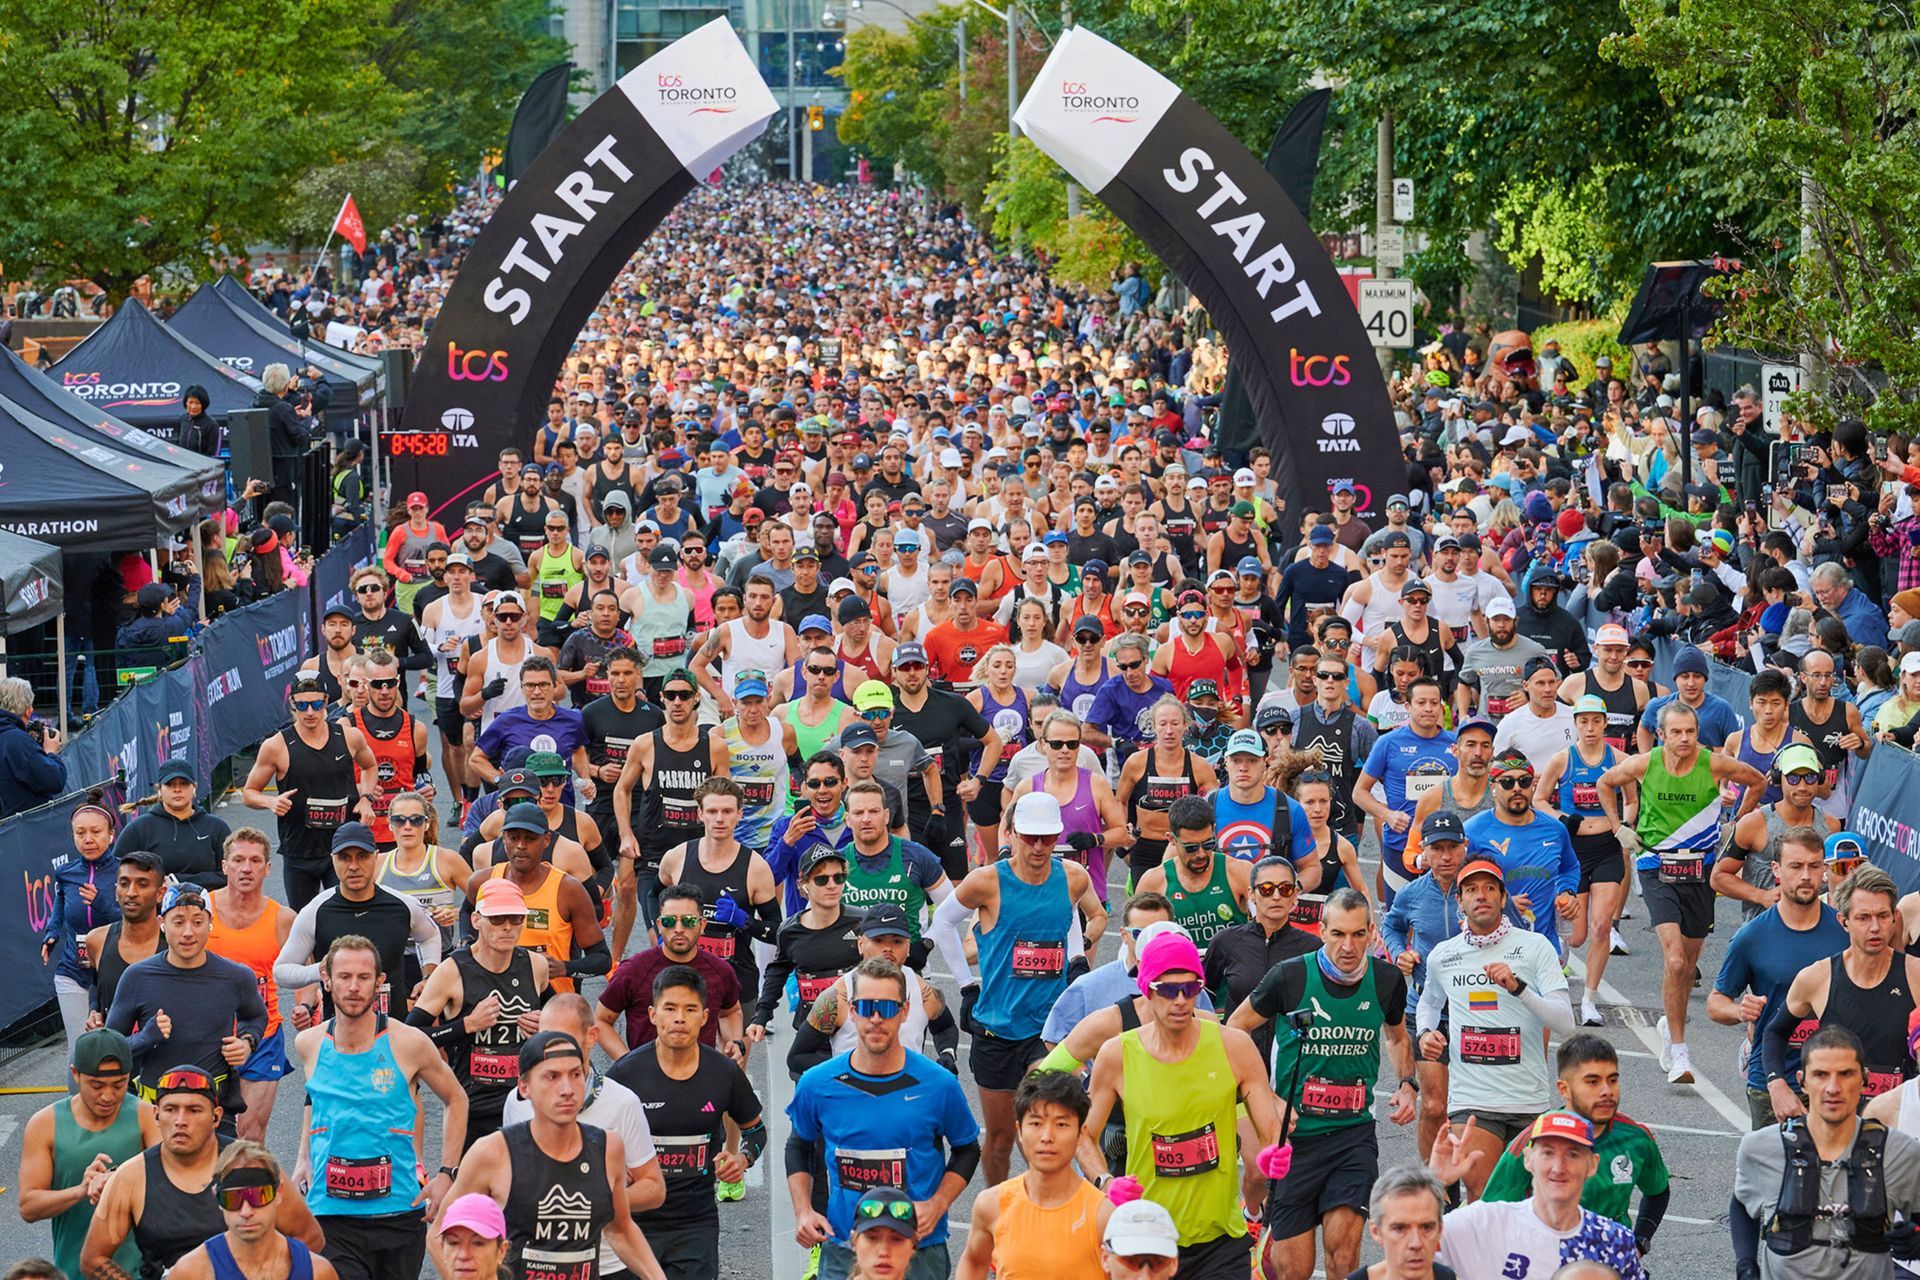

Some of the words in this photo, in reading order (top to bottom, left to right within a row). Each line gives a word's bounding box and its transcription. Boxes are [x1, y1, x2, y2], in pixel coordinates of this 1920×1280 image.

[658, 73, 682, 86] tcs
[1062, 80, 1086, 94] tcs
[658, 88, 736, 101] TORONTO
[1062, 96, 1138, 109] TORONTO
[483, 134, 633, 325] START
[1163, 147, 1322, 323] START
[1365, 289, 1407, 299] MAXIMUM
[1366, 310, 1407, 338] 40
[448, 341, 509, 381] tcs
[1290, 348, 1351, 387] tcs
[64, 382, 181, 396] TORONTO
[1772, 378, 1787, 388] TAXI
[392, 434, 447, 455] 8:45:28
[1317, 439, 1361, 452] TATA
[1264, 707, 1290, 719] ciele
[1150, 789, 1176, 798] 10086
[1657, 792, 1697, 803] ELEVATE
[309, 812, 335, 821] 10177
[665, 810, 690, 820] 13013
[1857, 806, 1920, 862] #CHOOSETORU
[1662, 865, 1688, 876] 17576
[843, 887, 908, 904] TORONTO
[1175, 910, 1217, 926] uelph
[1017, 957, 1046, 968] 2599
[1309, 1026, 1375, 1042] ORONTO
[1301, 1043, 1369, 1057] HARRIERS
[1463, 1042, 1496, 1054] 5743
[475, 1055, 498, 1064] STEPHEN
[474, 1063, 507, 1076] 2406
[1308, 1085, 1327, 1093] ADAM
[1308, 1093, 1342, 1106] 1740
[1156, 1144, 1173, 1152] MATT
[1158, 1153, 1184, 1165] 603
[330, 1165, 347, 1174] EVAN
[841, 1165, 879, 1182] 10289
[330, 1174, 365, 1188] 2404
[526, 1262, 557, 1271] KASHTIN
